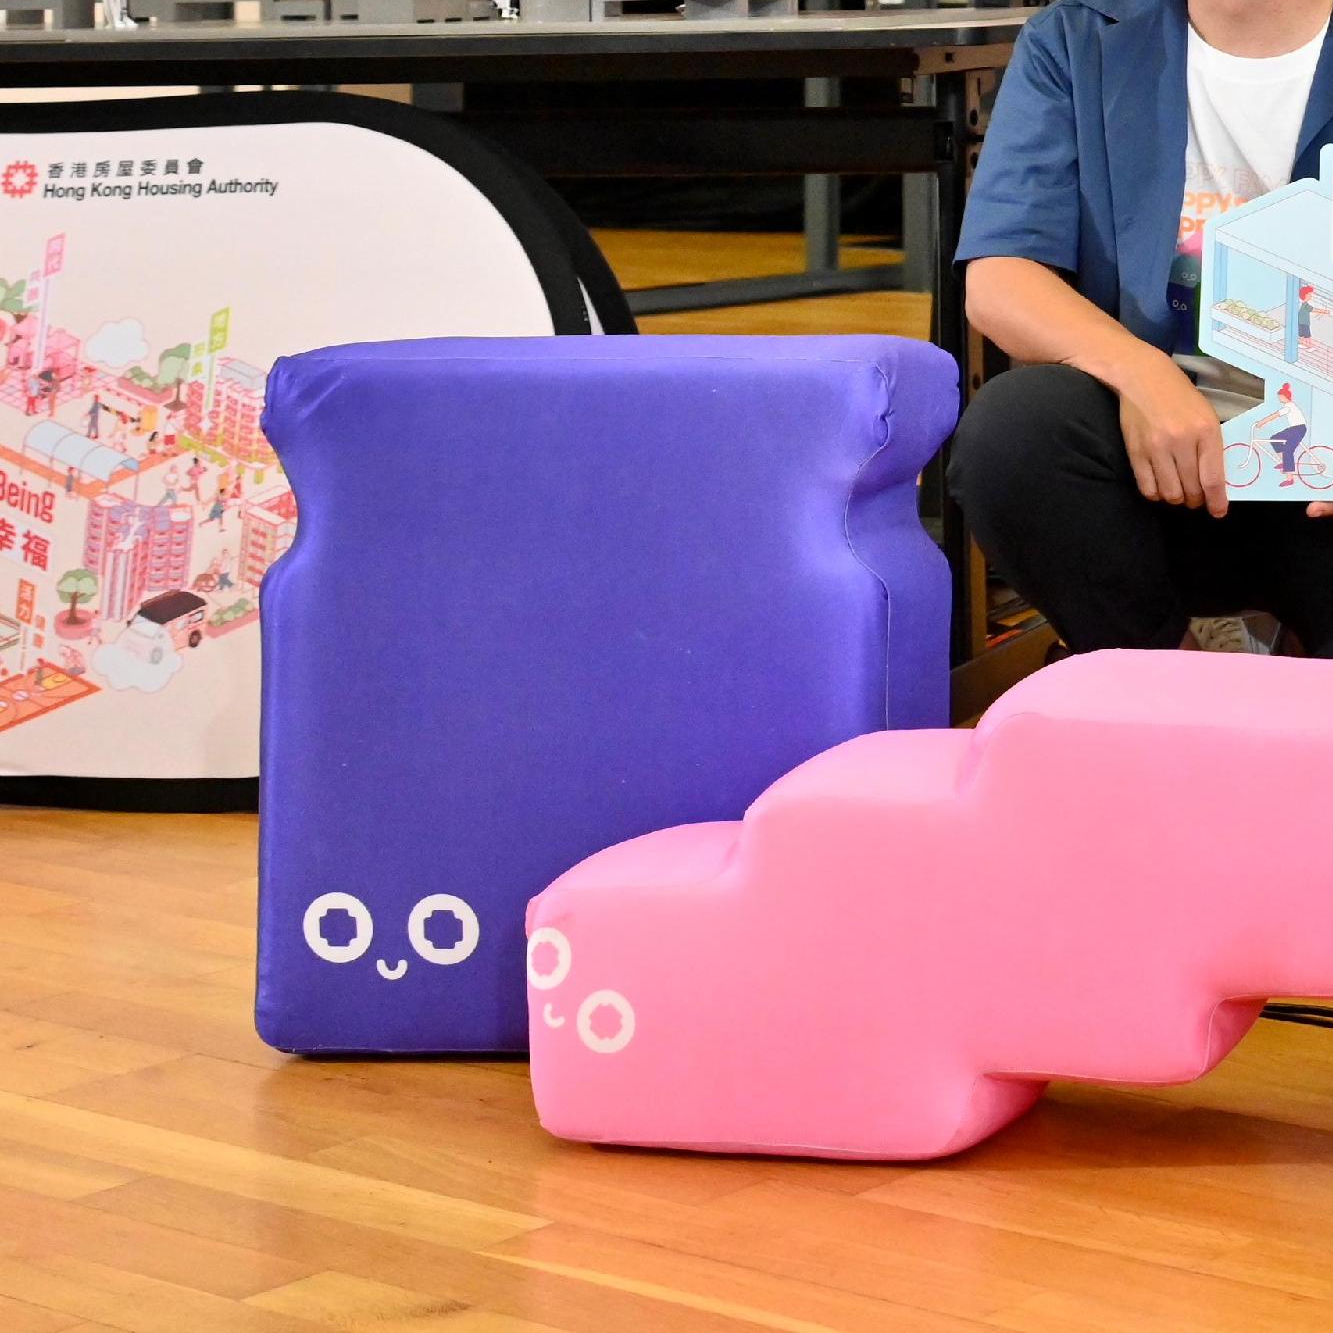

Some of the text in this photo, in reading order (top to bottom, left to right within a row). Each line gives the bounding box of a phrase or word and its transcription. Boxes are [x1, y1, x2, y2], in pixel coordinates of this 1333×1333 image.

[48, 157, 204, 179] 香港房屋委員會
[43, 177, 278, 200] Hong Kong Housing Authority
[0, 469, 56, 524] eing
